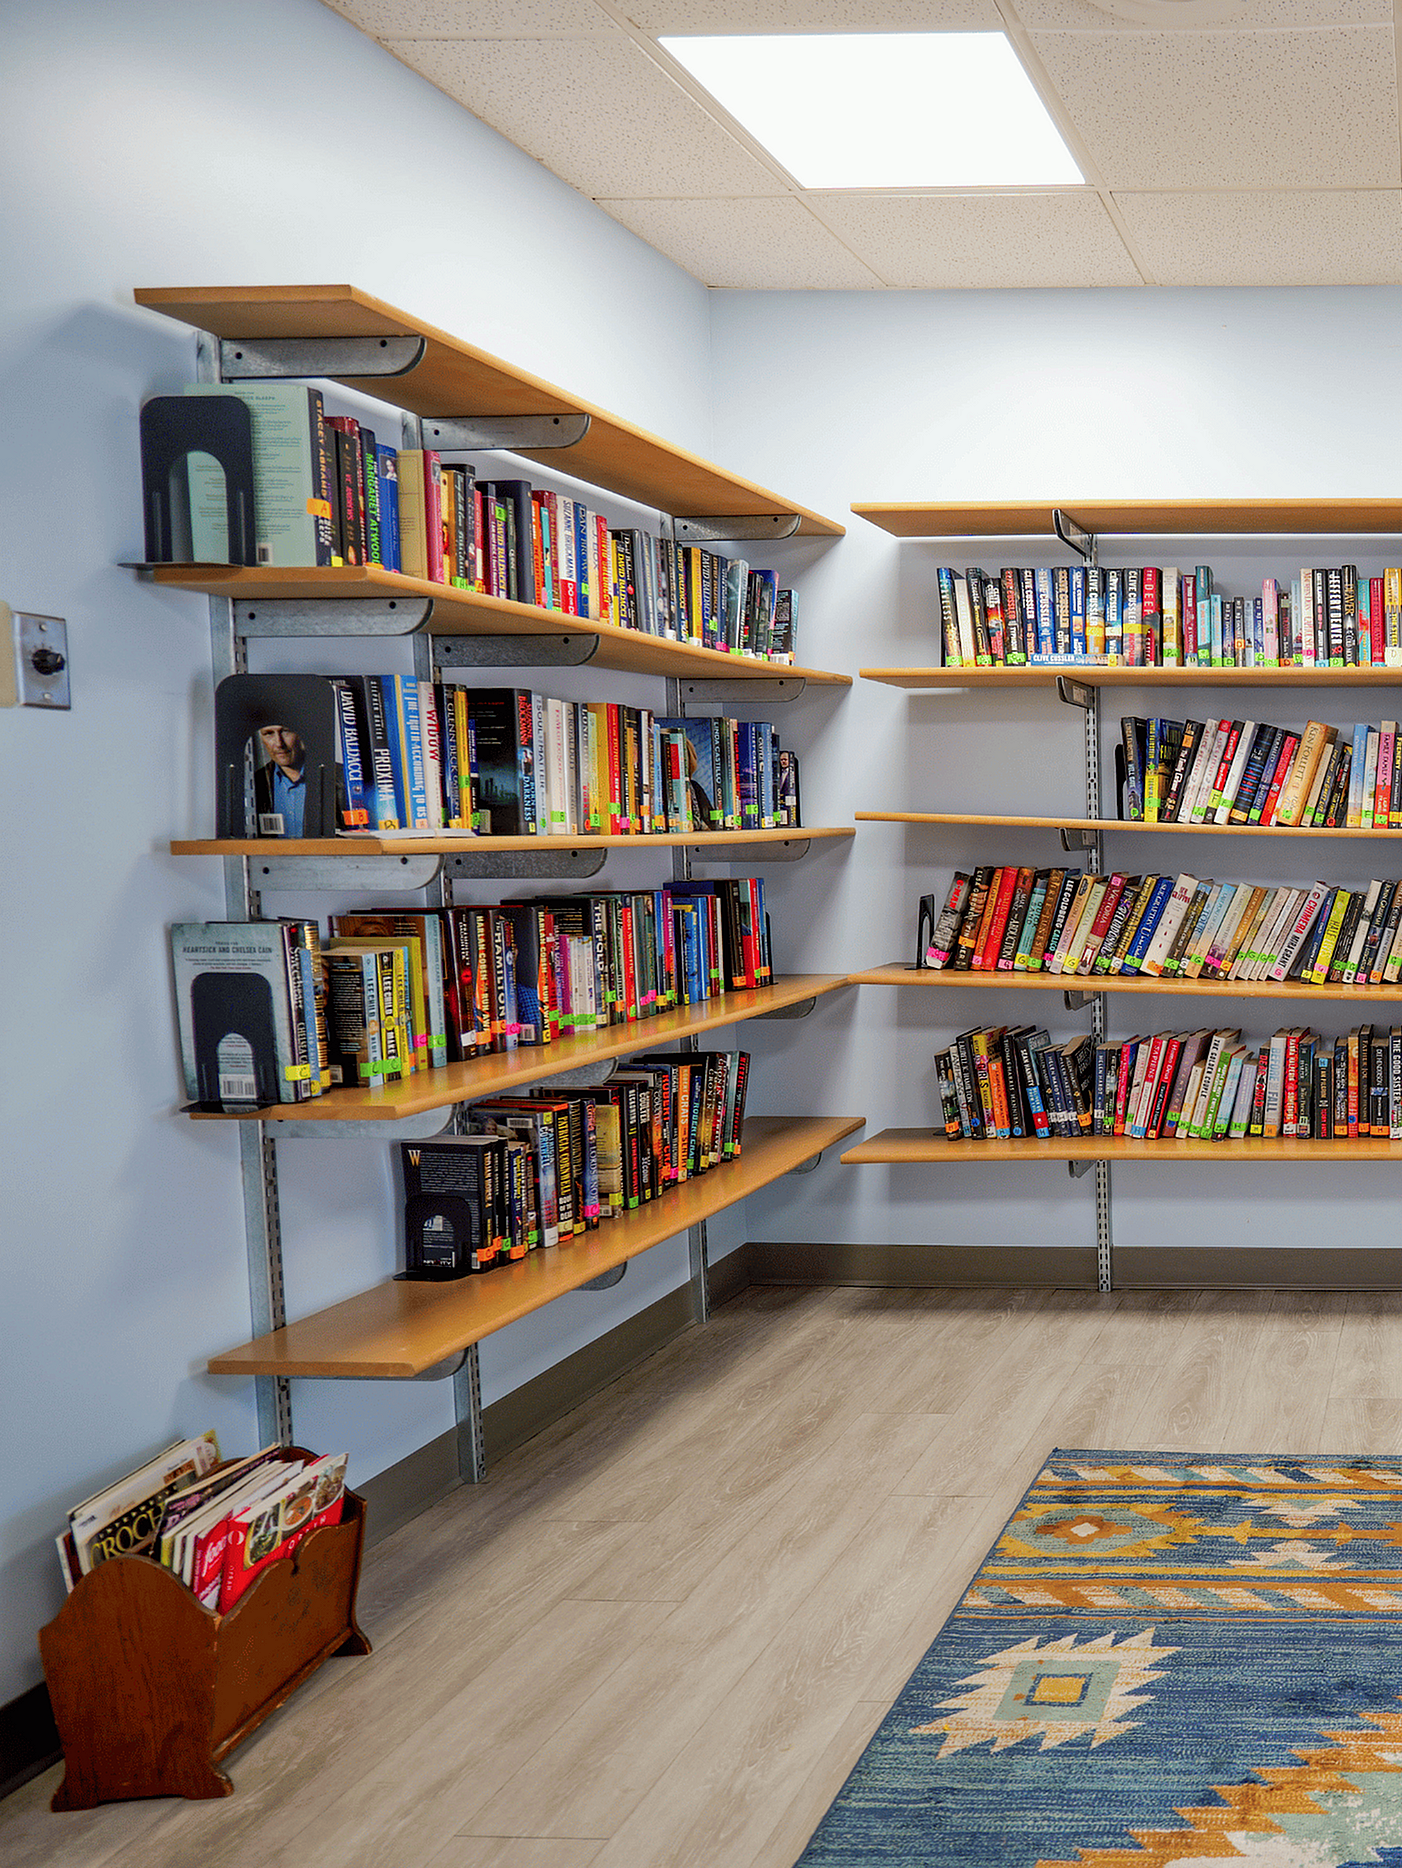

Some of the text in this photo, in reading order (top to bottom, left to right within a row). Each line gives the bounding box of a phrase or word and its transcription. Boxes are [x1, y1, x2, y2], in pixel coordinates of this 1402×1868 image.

[316, 400, 327, 498] STACEY ABRAMS
[562, 500, 574, 579] SUZANNE BROCKMANN
[579, 507, 588, 583] DAN BROWN
[617, 553, 627, 617] DAVID BALDACCI
[702, 553, 711, 620] DAVID BALDACCI
[1025, 570, 1034, 619] CLIVE CUSSLER
[1089, 570, 1099, 626] CLIVE CUSSLER
[1109, 592, 1117, 621] CUSSLER
[1128, 570, 1139, 624] CLIVE CUSSLER
[1329, 575, 1342, 644] JEFFERY DEAVER
[1344, 584, 1354, 616] DEAVER
[340, 690, 363, 781] DAVID BALDACCI
[426, 709, 440, 761] WIDOW
[447, 703, 457, 772] GLENN BECK
[518, 696, 528, 745] BROCKMANN
[374, 749, 395, 801] PROXIMA
[404, 697, 427, 818] THE TRUTH ACCORDING TO US
[1295, 726, 1319, 781] KEN FOLLETT
[523, 776, 533, 821] DARKNESS
[975, 871, 983, 885] LISA
[538, 912, 546, 944] HARLAN
[1049, 880, 1074, 951] LEE GOLDBERG CALICO
[1100, 889, 1120, 924] VICTORIA
[1141, 883, 1167, 935] SUE GRAFTON U
[1294, 900, 1318, 935] CHIMERA
[1374, 883, 1392, 926] JOHN GRISHAM
[594, 905, 604, 971] THE FOLD
[1002, 918, 1019, 959] ABDUCTION
[1277, 948, 1294, 968] GRANT
[1286, 935, 1300, 950] MIRA
[289, 946, 303, 1010] Sweetheart
[494, 932, 505, 1017] HAMILTON
[382, 976, 395, 1055] LEE CHILD MAKE
[1003, 1040, 1015, 1091] THOMAS HARRIS
[1148, 1046, 1160, 1078] SAPIENS
[1200, 1039, 1221, 1098] THE GOLDEN COUPLE
[1393, 1039, 1401, 1053] THE
[1393, 1055, 1401, 1074] GOOD
[662, 1075, 670, 1122] ROBERT
[978, 1063, 990, 1089] GIRLS
[1267, 1048, 1282, 1112] BEFORE FALL
[540, 1126, 550, 1168] CORNWELL
[558, 1116, 571, 1196] PATRICIA CORNWELL
